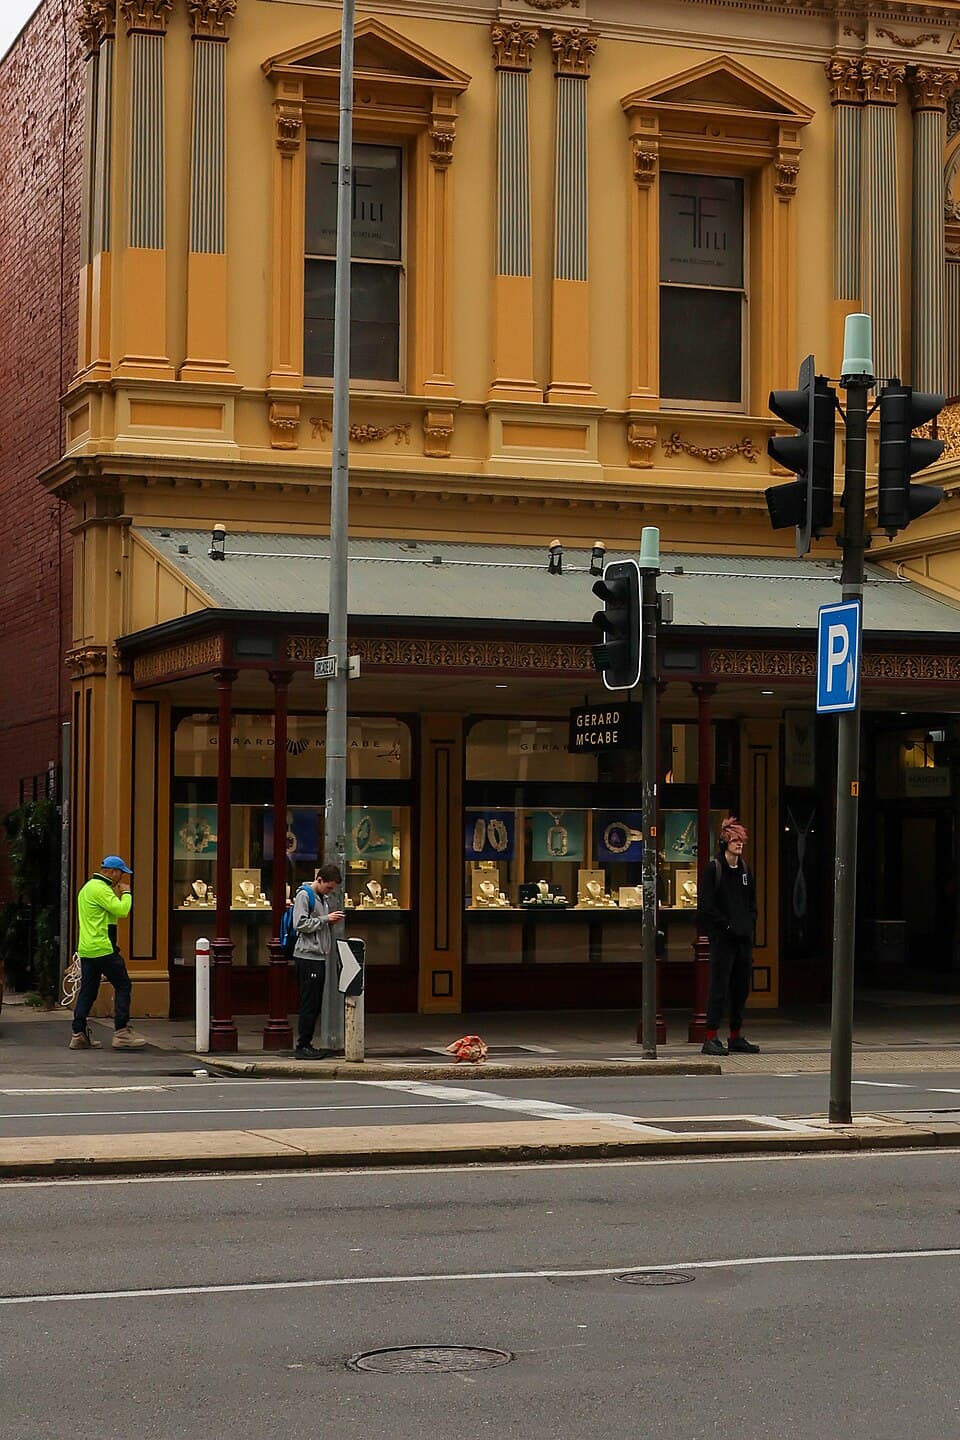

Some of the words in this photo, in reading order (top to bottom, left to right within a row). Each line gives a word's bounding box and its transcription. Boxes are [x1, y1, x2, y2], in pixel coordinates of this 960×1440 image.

[826, 623, 850, 692] P
[576, 711, 620, 727] GERARD
[209, 737, 275, 746] GRARD
[315, 740, 381, 748] MABE
